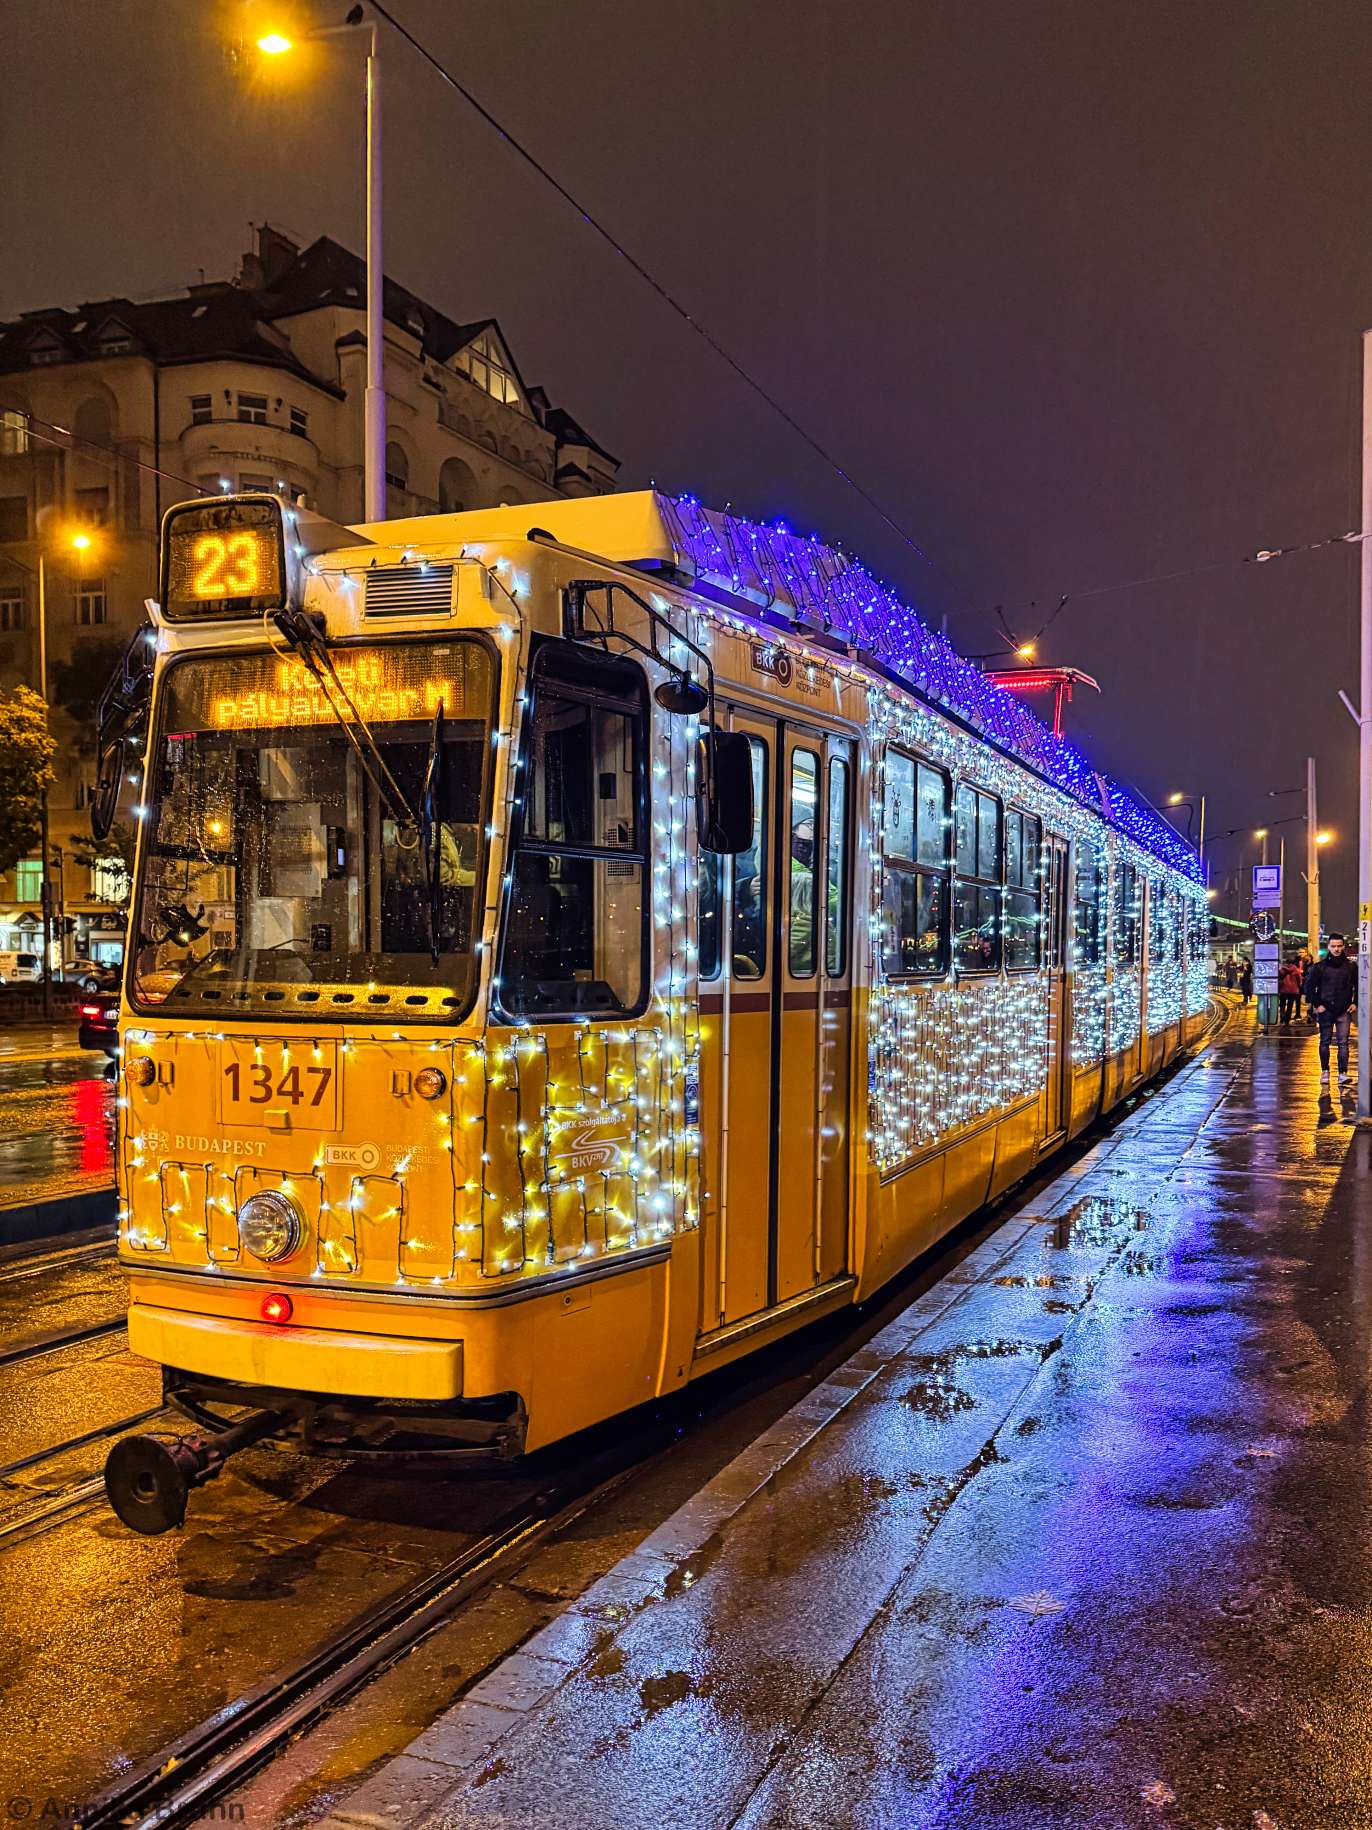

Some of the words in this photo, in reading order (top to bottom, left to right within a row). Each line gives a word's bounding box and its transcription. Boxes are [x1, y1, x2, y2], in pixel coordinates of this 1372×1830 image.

[194, 536, 258, 594] 23
[756, 652, 775, 670] BKK
[224, 1062, 332, 1107] 1347
[175, 1135, 267, 1157] BUDAPEST
[333, 1150, 357, 1161] BKK
